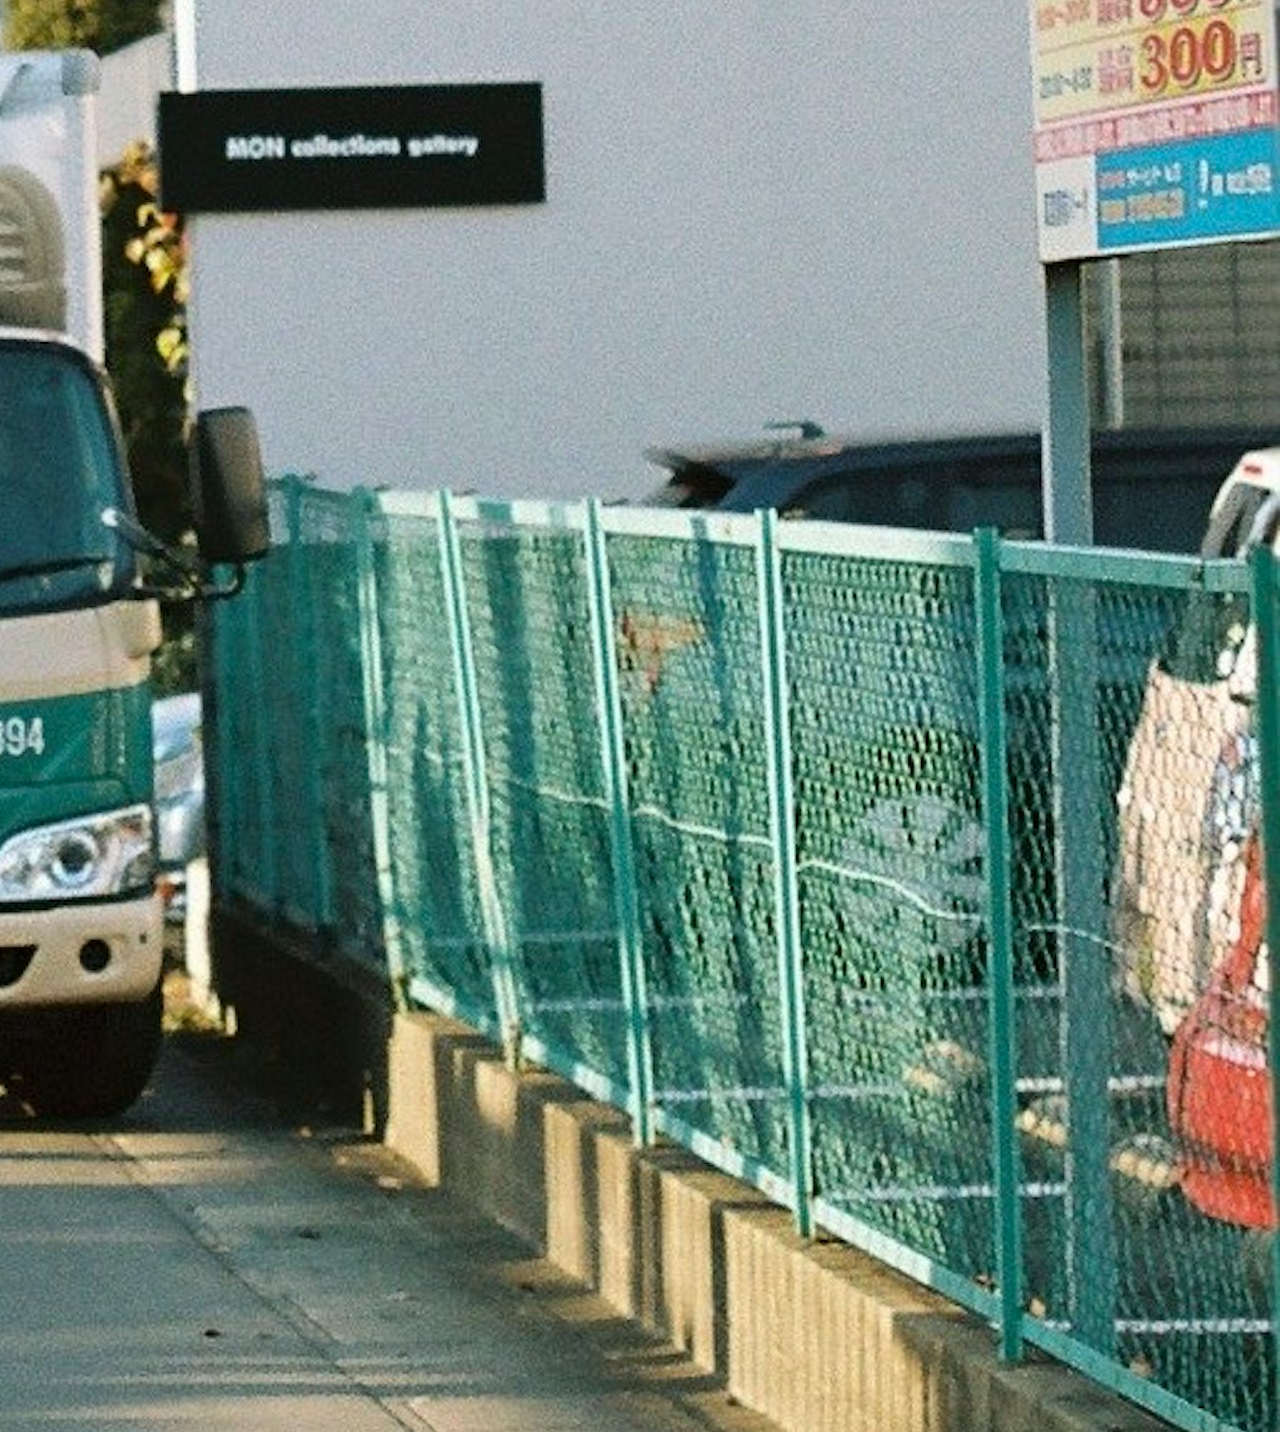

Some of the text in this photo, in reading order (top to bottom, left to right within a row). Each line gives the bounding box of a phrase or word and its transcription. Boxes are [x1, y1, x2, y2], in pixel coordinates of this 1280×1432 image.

[1140, 19, 1261, 92] 300円
[226, 134, 479, 159] MON collections gallery
